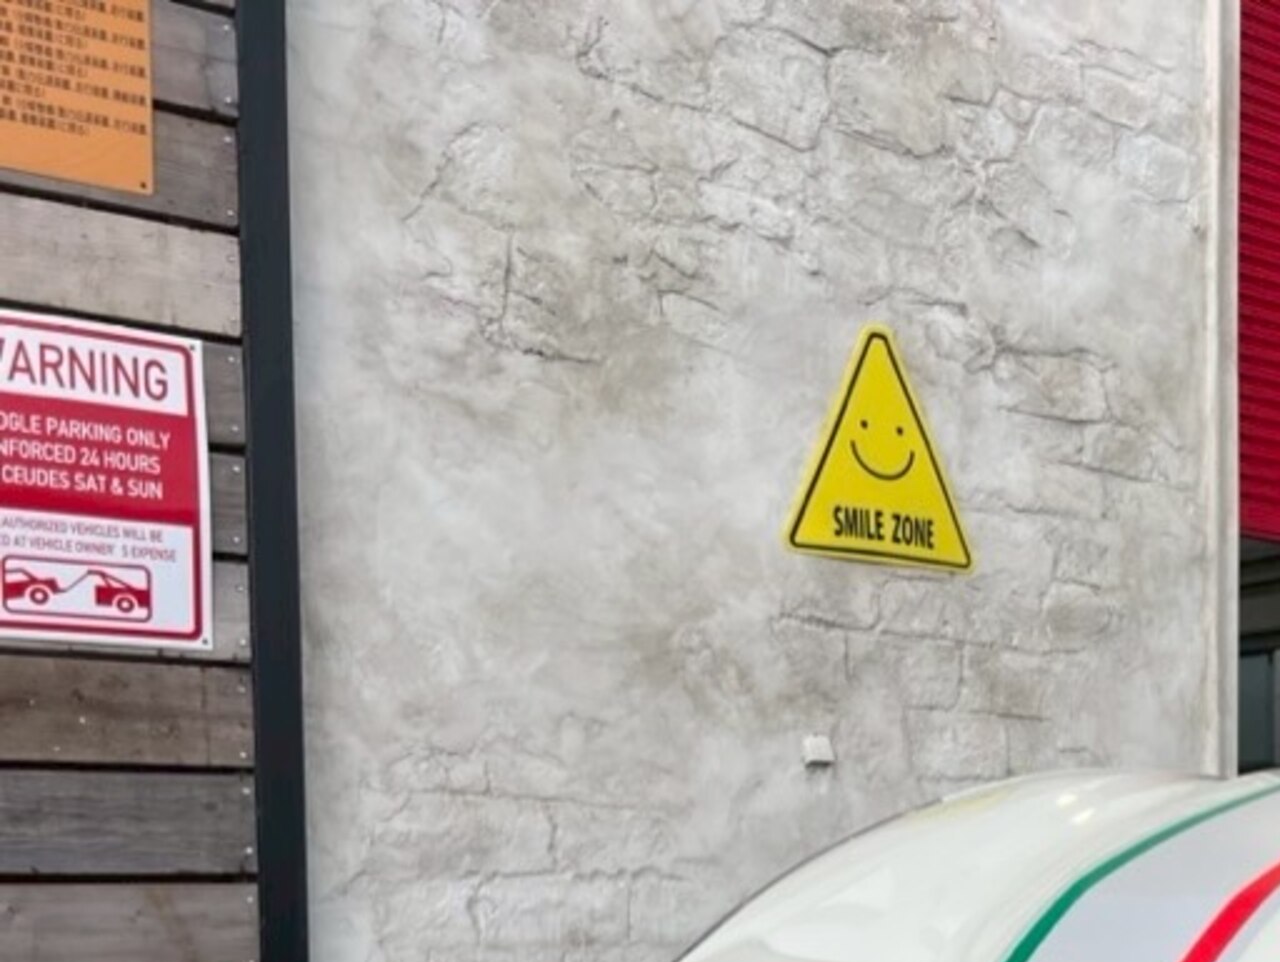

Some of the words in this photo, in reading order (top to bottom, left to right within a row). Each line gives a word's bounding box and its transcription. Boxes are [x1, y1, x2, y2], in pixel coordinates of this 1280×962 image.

[0, 337, 168, 401] ARNING
[46, 416, 122, 444] PARKING
[126, 427, 171, 451] ONLY
[80, 446, 100, 467] 24
[104, 449, 161, 475] HOURS
[74, 472, 106, 493] SAT
[110, 476, 123, 496] &
[127, 478, 163, 500] SUN
[70, 521, 120, 538] VEHICLES
[122, 527, 146, 541] WILL
[150, 529, 163, 543] BE
[833, 504, 885, 541] SMILE
[891, 514, 934, 549] ZONE
[29, 537, 72, 553] VEHICLE
[131, 546, 176, 563] EXPENSE
